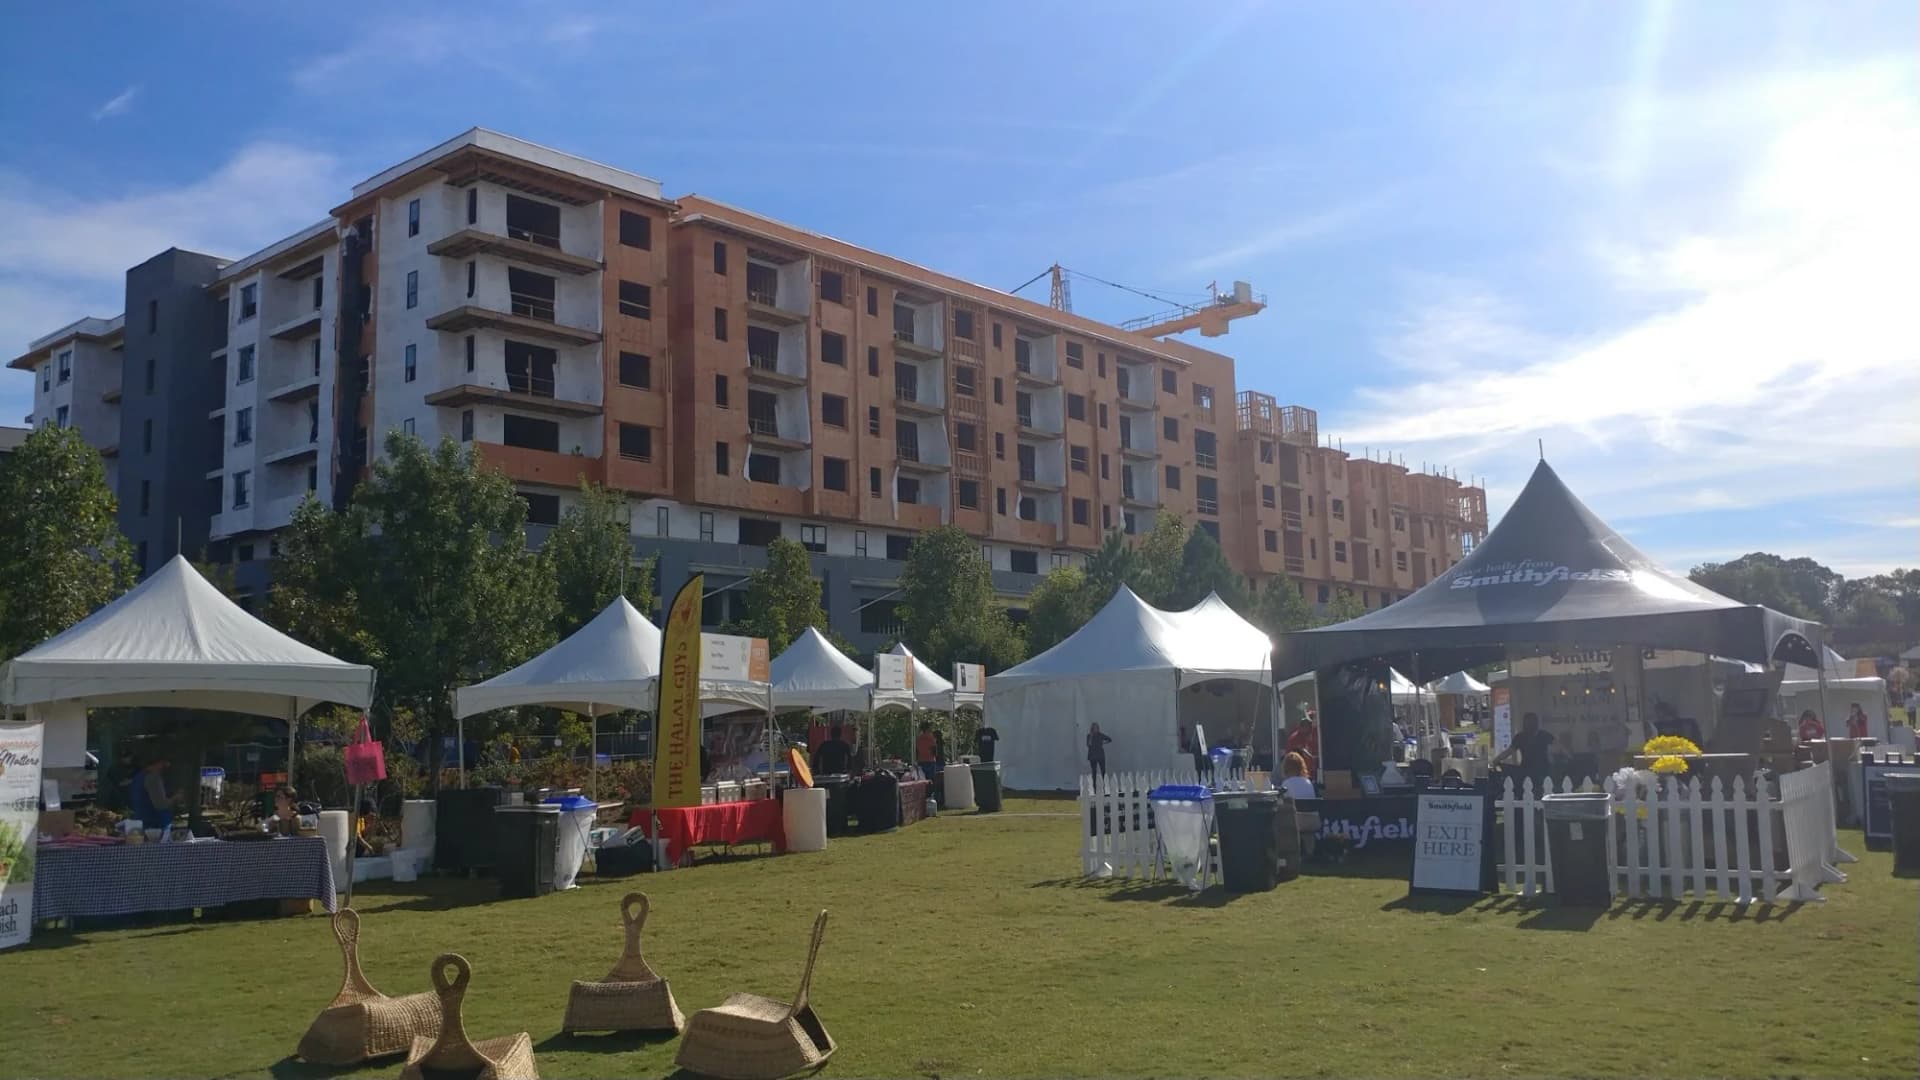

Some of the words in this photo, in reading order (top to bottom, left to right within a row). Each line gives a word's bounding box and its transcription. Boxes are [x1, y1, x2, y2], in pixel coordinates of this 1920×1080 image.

[674, 641, 688, 690] GUYS
[670, 696, 685, 756] HALAL
[0, 748, 40, 768] Matters
[668, 760, 683, 799] THE
[1427, 825, 1473, 841] EXIT
[1423, 841, 1475, 857] HERE
